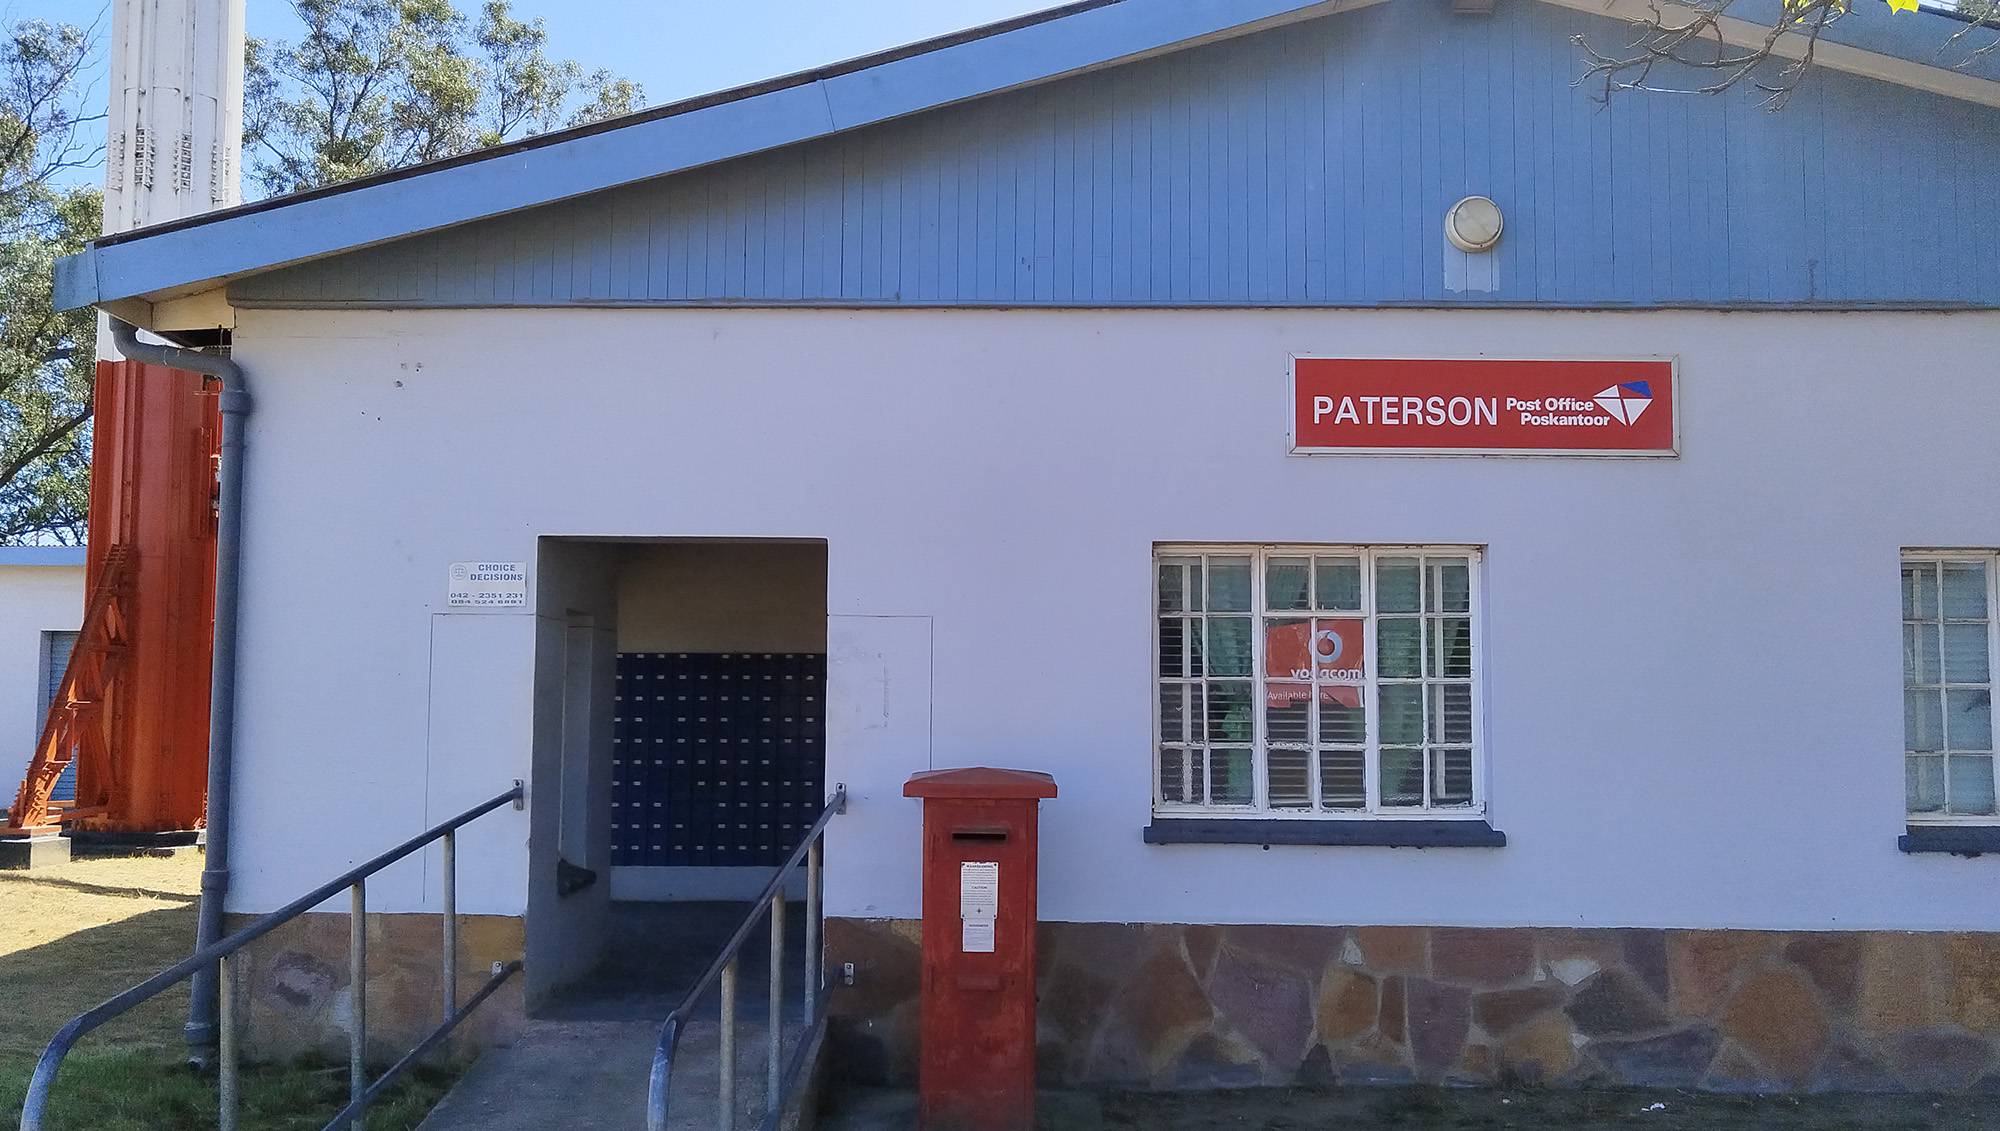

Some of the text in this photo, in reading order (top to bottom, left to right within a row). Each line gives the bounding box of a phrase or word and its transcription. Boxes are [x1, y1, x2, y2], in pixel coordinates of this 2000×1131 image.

[1506, 397, 1594, 411] Post Office
[1313, 396, 1498, 425] PATERSON
[1520, 412, 1610, 427] Poskantoor
[478, 564, 517, 572] CHOICE
[470, 573, 523, 581] DECISIONS
[1290, 668, 1361, 680] voacom
[1268, 690, 1307, 701] Available
